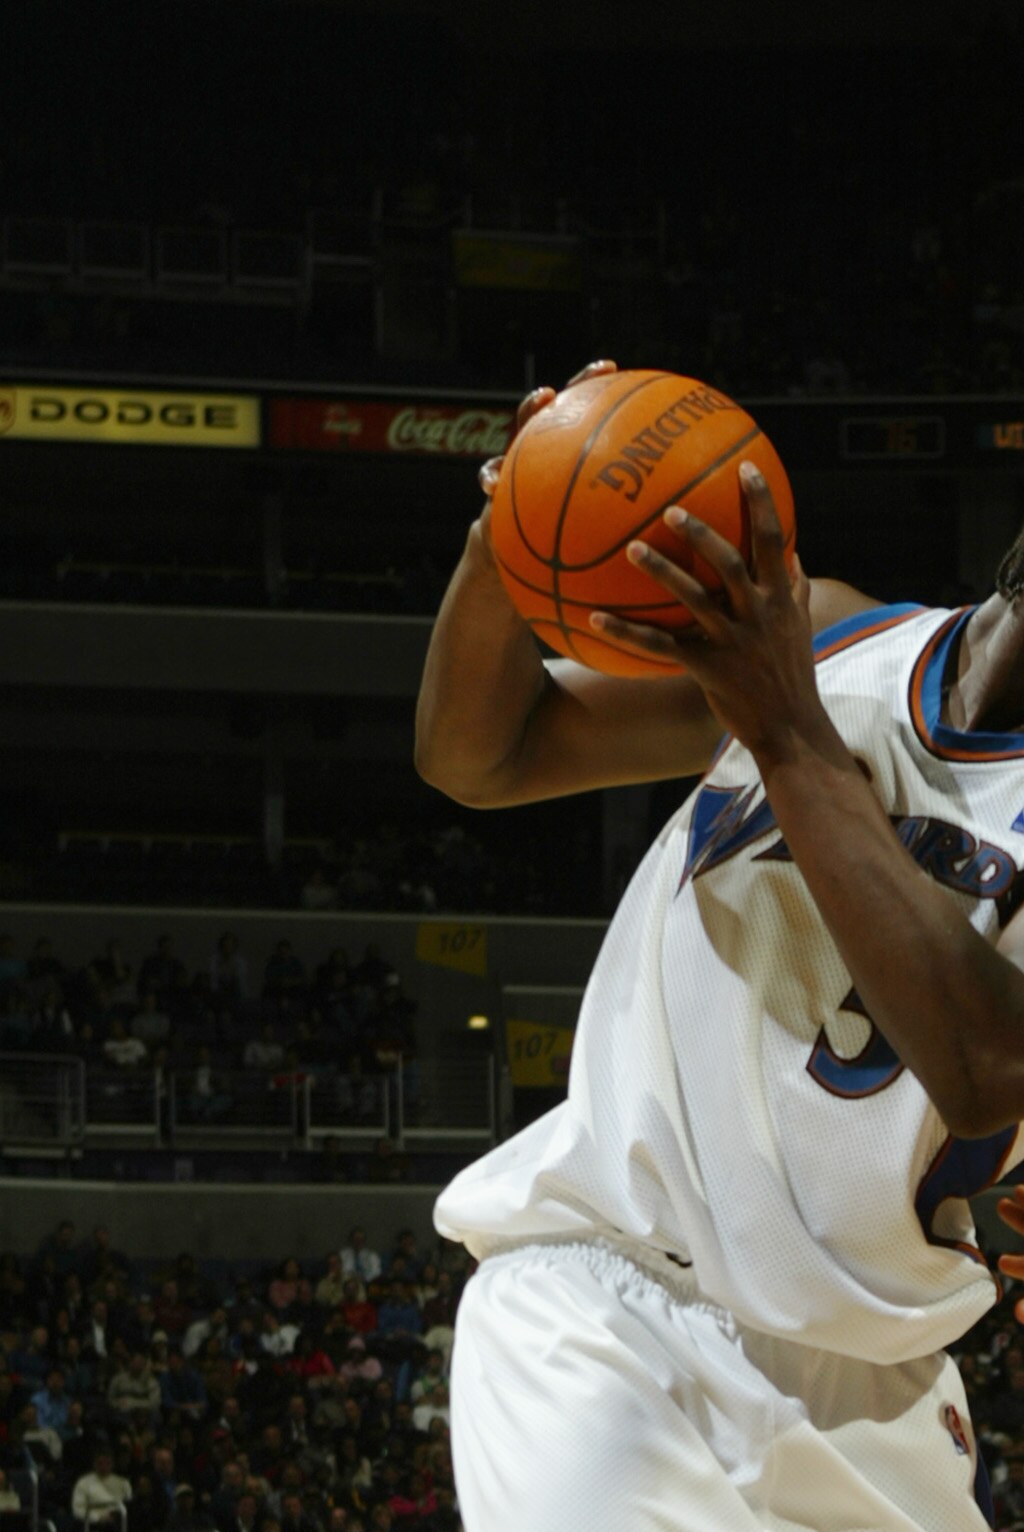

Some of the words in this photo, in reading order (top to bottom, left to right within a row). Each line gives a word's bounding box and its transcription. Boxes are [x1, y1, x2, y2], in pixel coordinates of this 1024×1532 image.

[31, 399, 237, 428] DODGE
[439, 928, 482, 954] 107
[513, 1030, 558, 1060] 107
